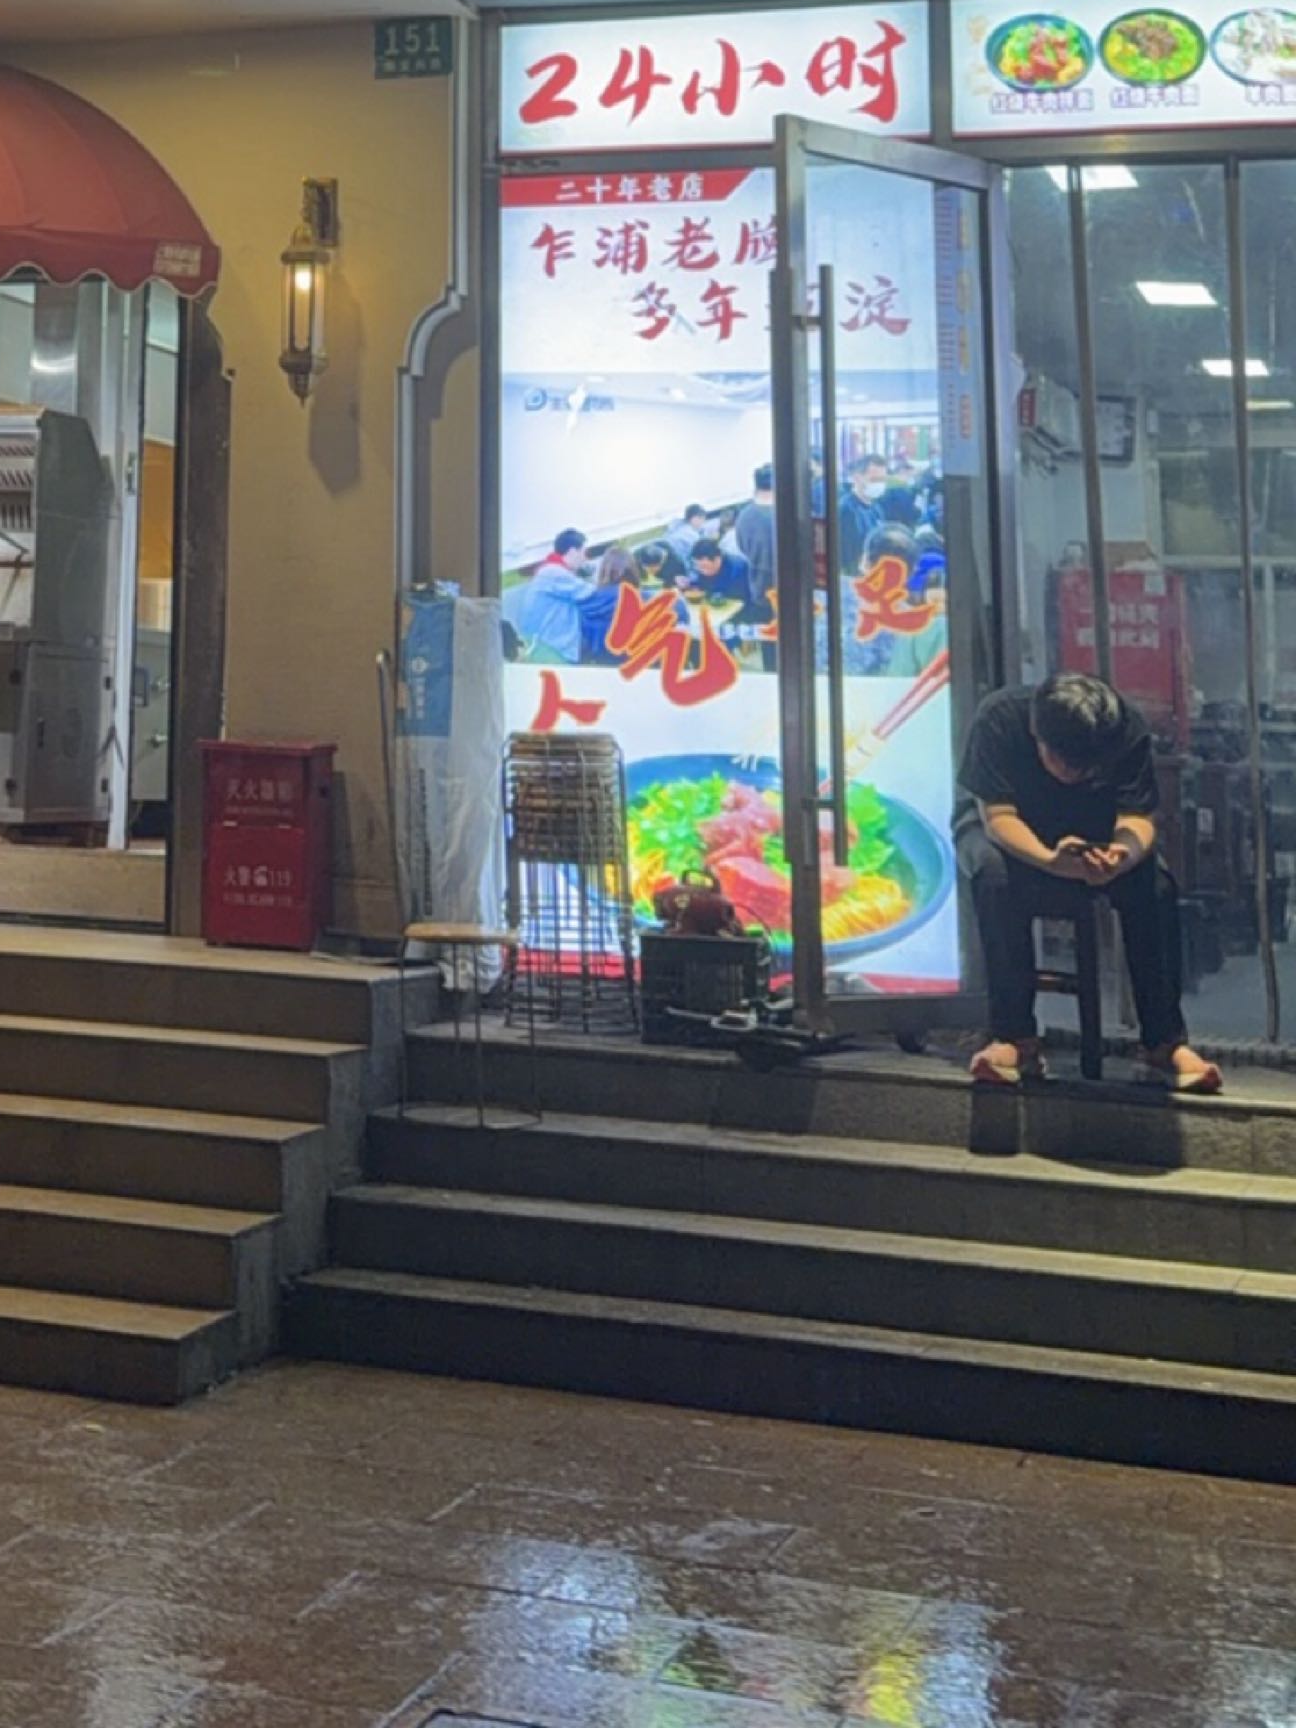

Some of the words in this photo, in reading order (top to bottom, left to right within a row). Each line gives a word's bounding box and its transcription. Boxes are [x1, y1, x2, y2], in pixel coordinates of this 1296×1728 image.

[383, 23, 442, 56] 151
[519, 20, 905, 125] 24小时
[555, 172, 703, 203] 二十年老店
[631, 275, 912, 341] 多年淀
[530, 554, 938, 736] 人气足
